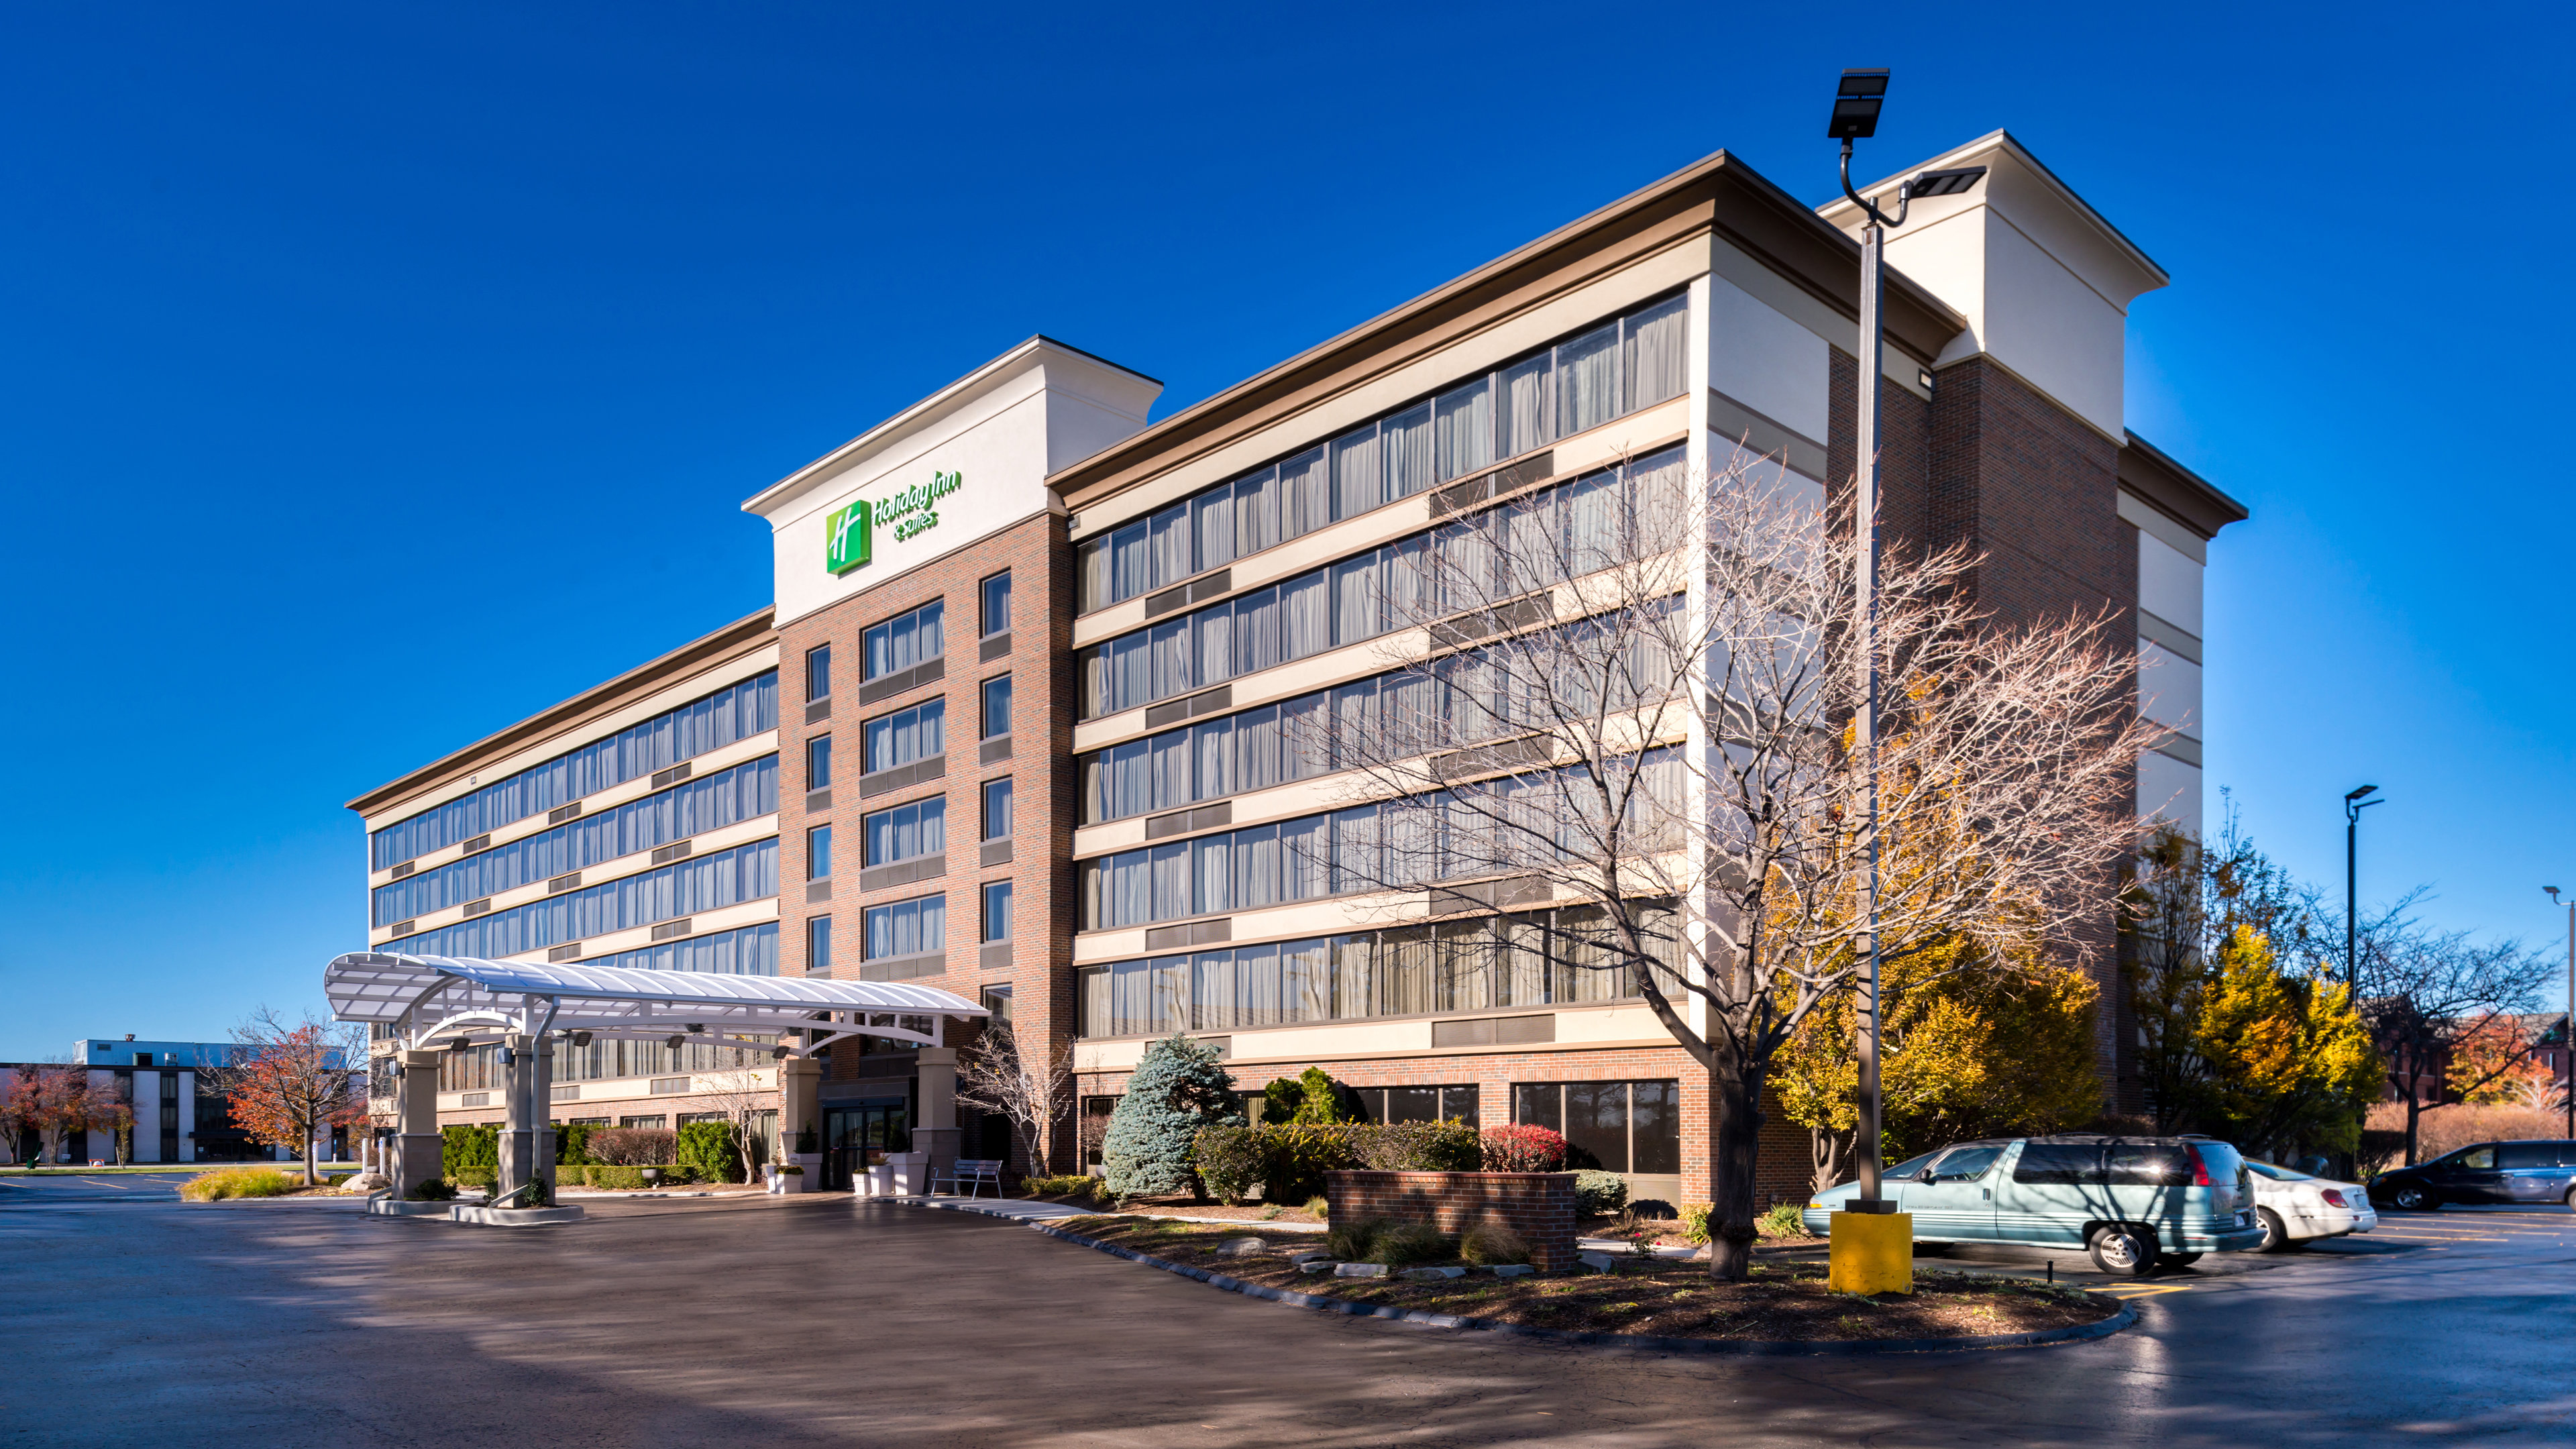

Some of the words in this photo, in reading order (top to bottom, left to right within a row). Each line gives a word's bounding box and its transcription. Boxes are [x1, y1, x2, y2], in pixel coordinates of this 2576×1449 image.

[871, 483, 932, 525] Holiday
[932, 470, 959, 496] Inn
[829, 507, 861, 561] H
[893, 524, 903, 540] &
[902, 511, 936, 536] Suites
